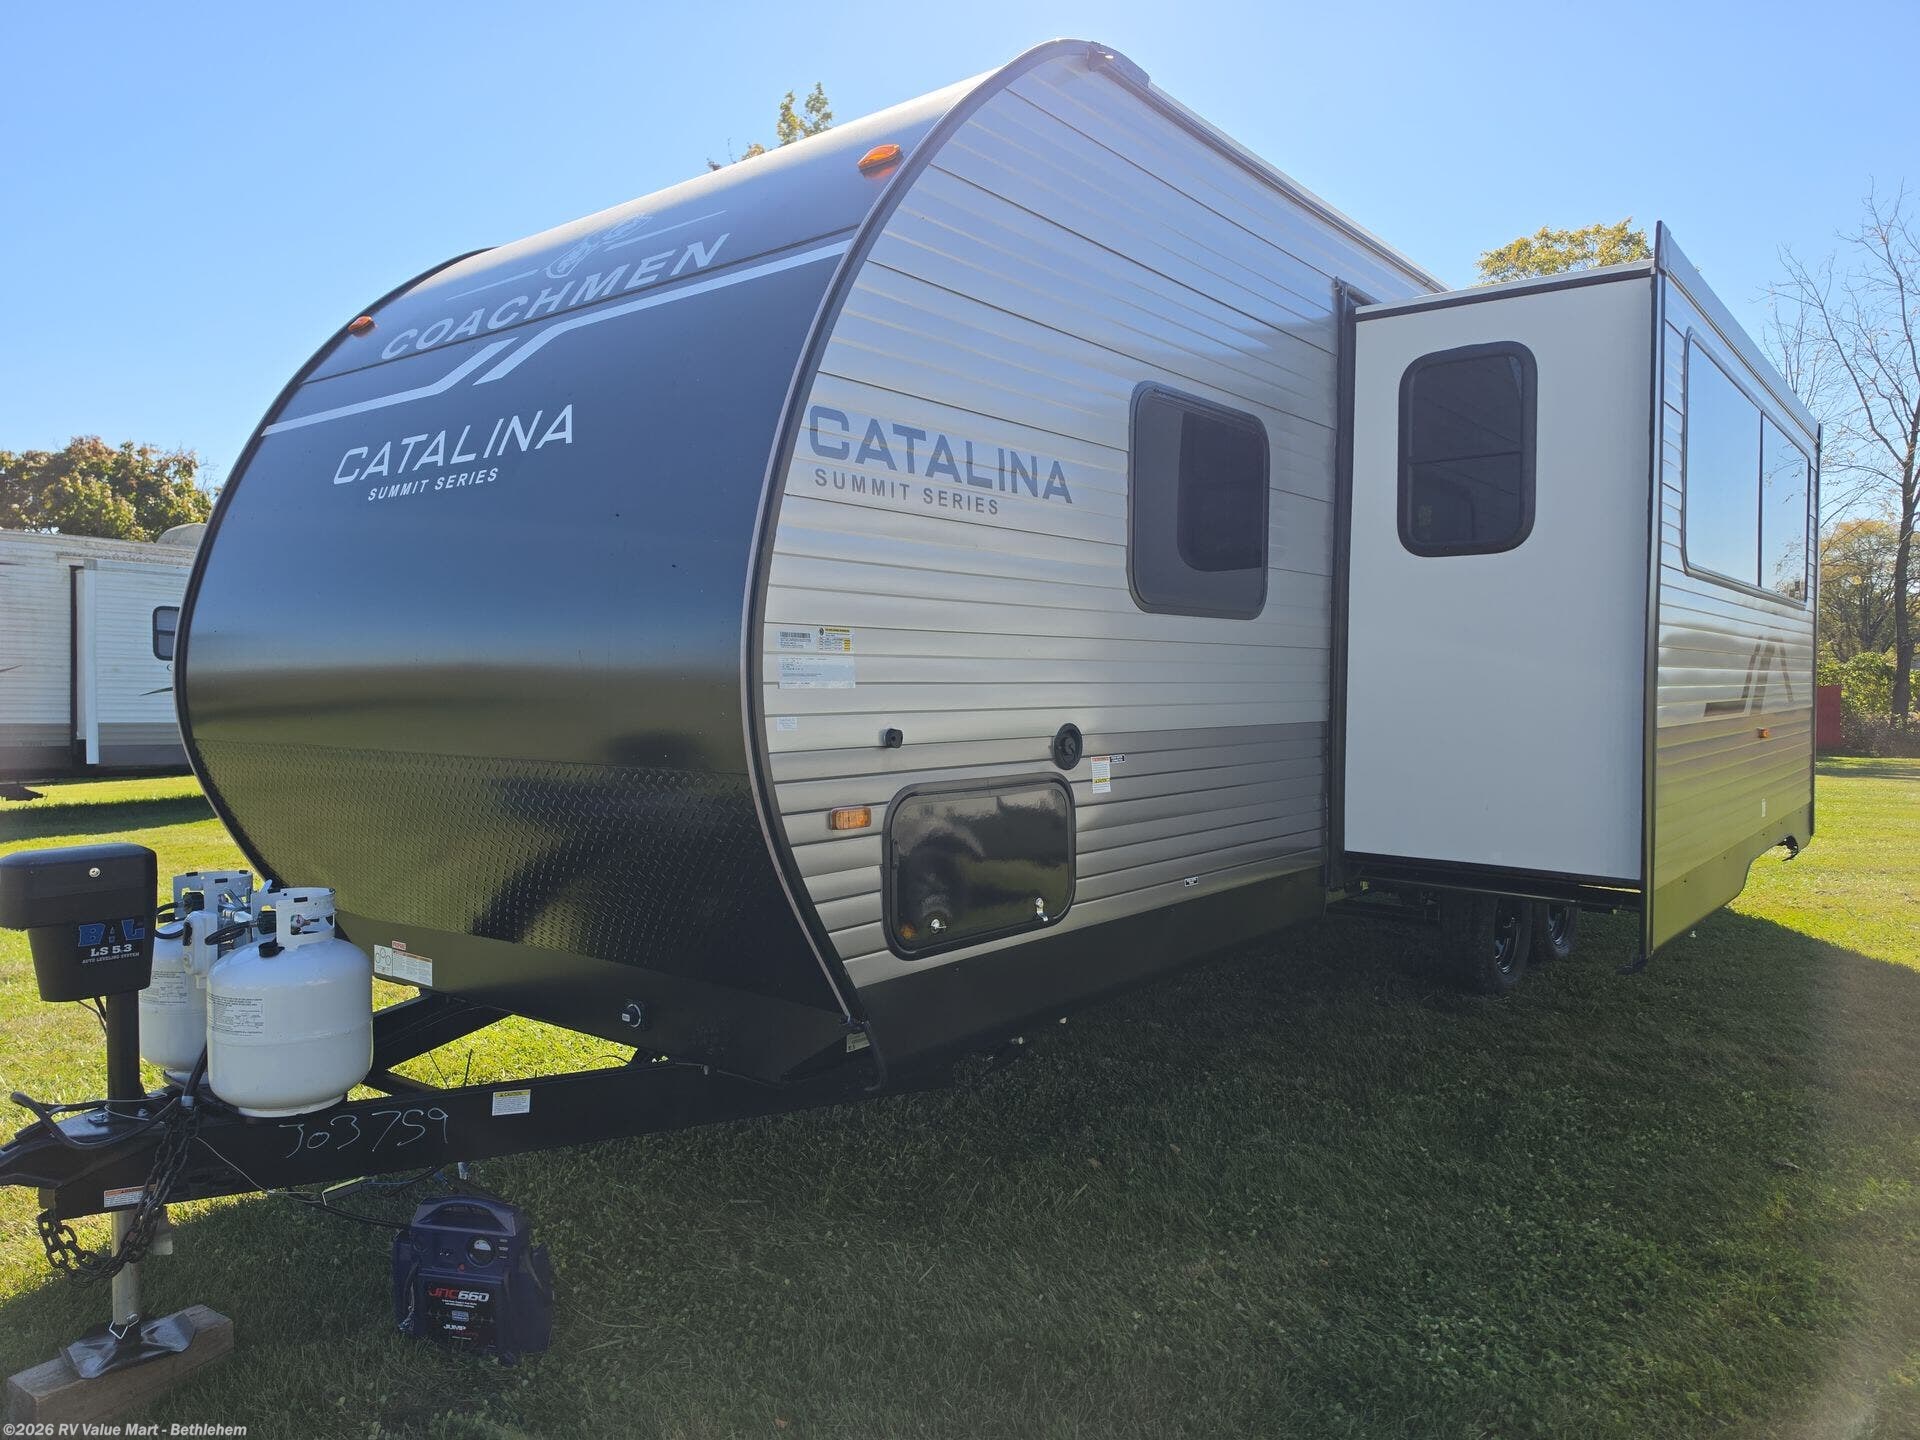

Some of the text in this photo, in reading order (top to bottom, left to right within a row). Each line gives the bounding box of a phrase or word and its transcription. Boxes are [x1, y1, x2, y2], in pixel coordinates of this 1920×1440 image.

[381, 232, 730, 361] COACHMEN
[333, 403, 574, 485] CATALINA
[809, 404, 1073, 504] CATALINA
[367, 467, 499, 501] SUMMIT SERIES
[814, 467, 999, 515] SUMMIT SERIES
[90, 946, 109, 957] LS
[443, 1323, 467, 1331] JUMP
